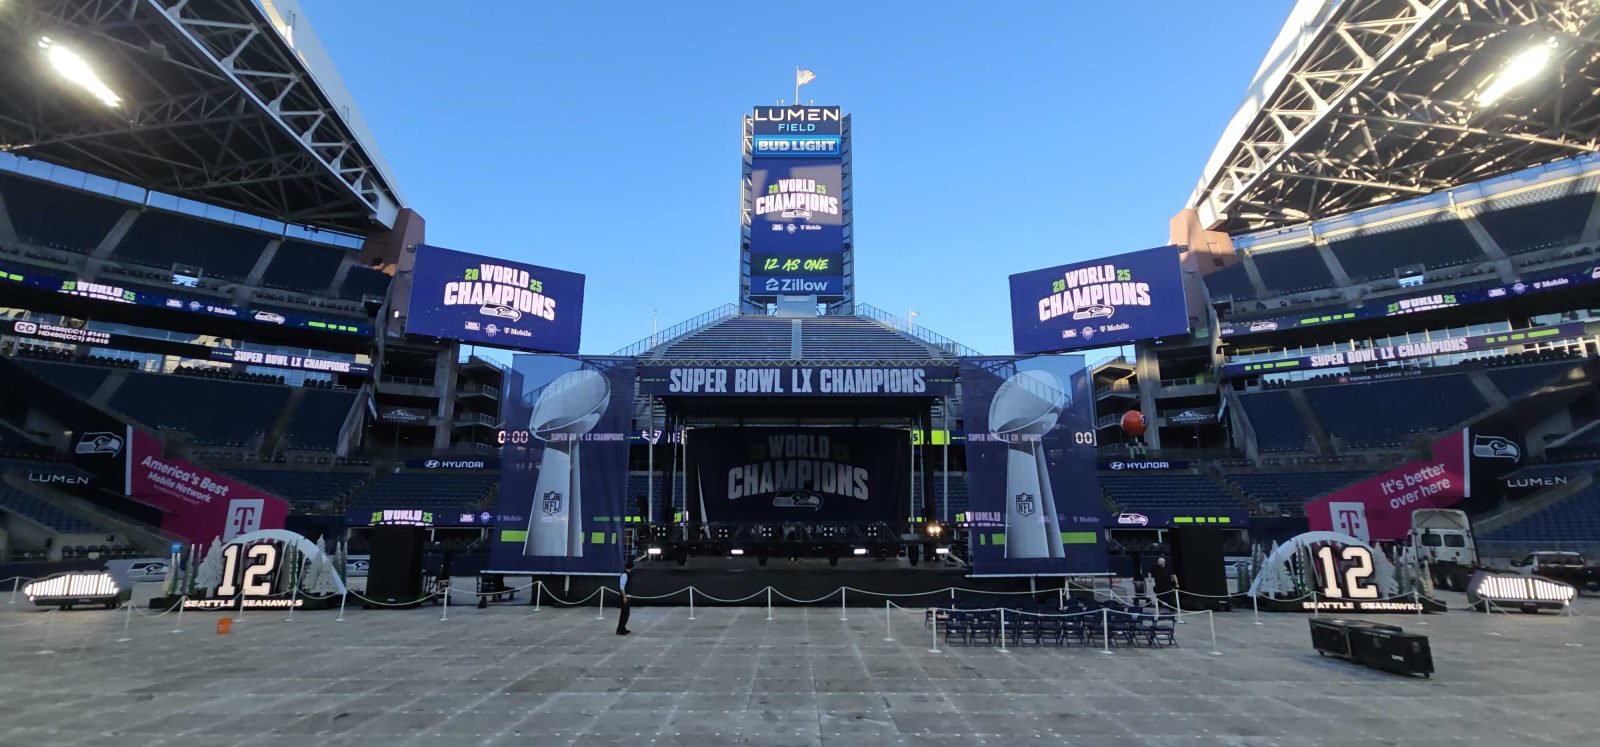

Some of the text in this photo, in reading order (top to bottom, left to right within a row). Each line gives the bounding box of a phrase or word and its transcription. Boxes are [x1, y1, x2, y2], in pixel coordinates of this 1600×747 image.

[755, 108, 839, 121] LUMEN
[778, 123, 816, 132] FIELD
[758, 140, 836, 151] BUD LIGHT
[779, 178, 816, 193] WORLD
[816, 185, 826, 195] 25
[755, 192, 838, 216] CHAMPIONS
[764, 257, 829, 272] 12 AS ONE
[464, 263, 543, 293] 20 WORLD 25
[781, 278, 828, 291] Zillow
[1053, 264, 1131, 293] 20 WORLD 25
[1542, 278, 1569, 288] Mobile
[123, 289, 136, 302] 25
[443, 281, 556, 321] CHAMPIONS
[1038, 282, 1151, 322] CHAMPIONS
[1443, 294, 1457, 305] 25
[16, 323, 34, 333] CC
[510, 328, 532, 337] Mobile
[1106, 323, 1130, 332] Mobile
[1310, 337, 1469, 367] SUPER BOWL LX CHAMPIONS
[234, 350, 350, 373] SUPER BOWL LX CHAMPIONS
[669, 367, 926, 394] SUPER BOWL LX CHAMPIONS
[497, 430, 529, 444] 0:00
[768, 434, 830, 459] WORLD
[441, 461, 484, 469] HYUNDAI
[1126, 461, 1169, 469] HYUNDAI
[28, 472, 89, 485] LUMEN
[141, 455, 201, 486] America's
[199, 476, 229, 498] Best
[727, 459, 869, 501] CHAMPIONS
[1381, 462, 1446, 496] It's better
[1507, 476, 1567, 488] LUMEN
[147, 471, 177, 489] Mobile
[175, 482, 213, 504] Network
[1390, 478, 1451, 510] over here
[543, 500, 561, 513] NFL
[1018, 502, 1033, 513] NFL
[422, 512, 433, 523] 25
[217, 544, 276, 596] 12
[1318, 546, 1378, 598] 12
[183, 599, 304, 608] SEATTLE SEAHAWKS
[1302, 601, 1424, 611] SEATTLE SEAHAWKS
